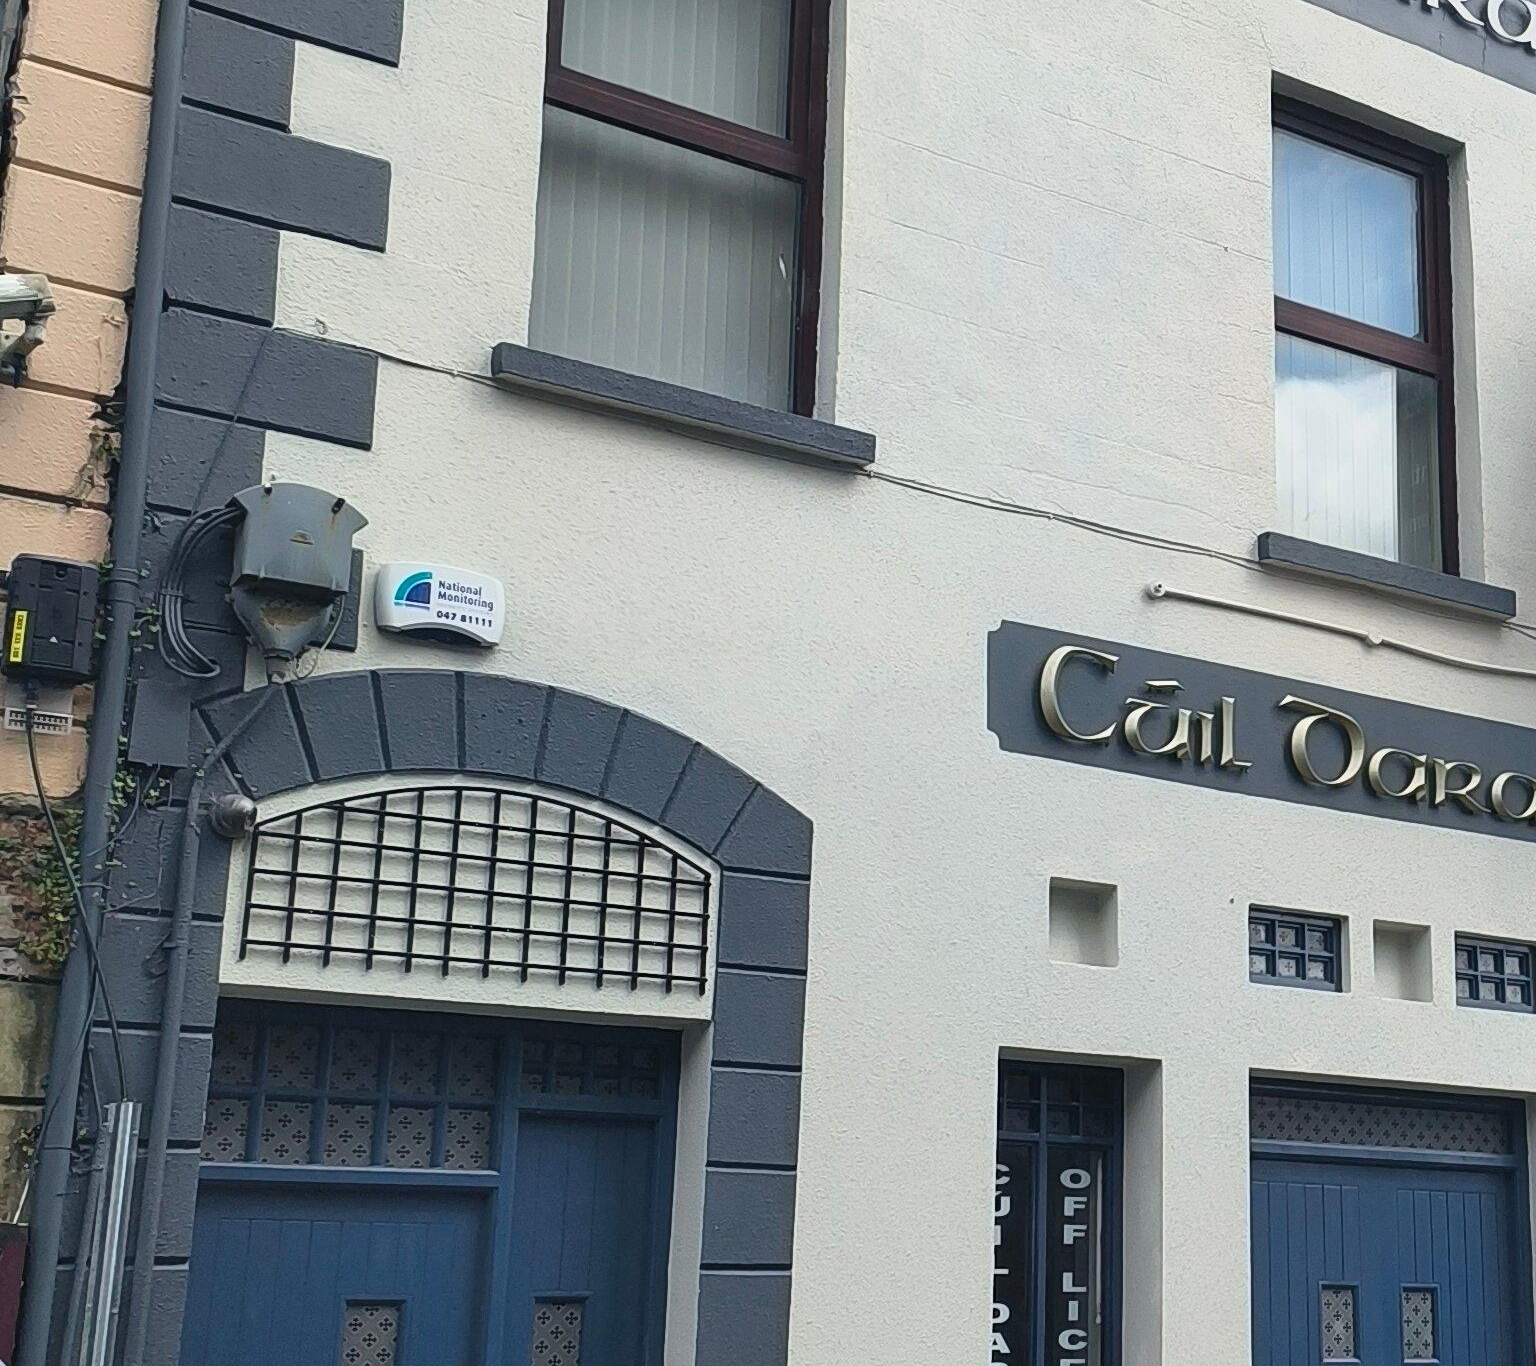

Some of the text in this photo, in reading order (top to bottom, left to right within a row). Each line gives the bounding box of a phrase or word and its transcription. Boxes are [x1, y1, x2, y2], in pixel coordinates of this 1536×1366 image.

[438, 580, 482, 595] National
[437, 591, 494, 611] Monitoring
[436, 610, 457, 621] 047
[1059, 1167, 1091, 1246] OFF
